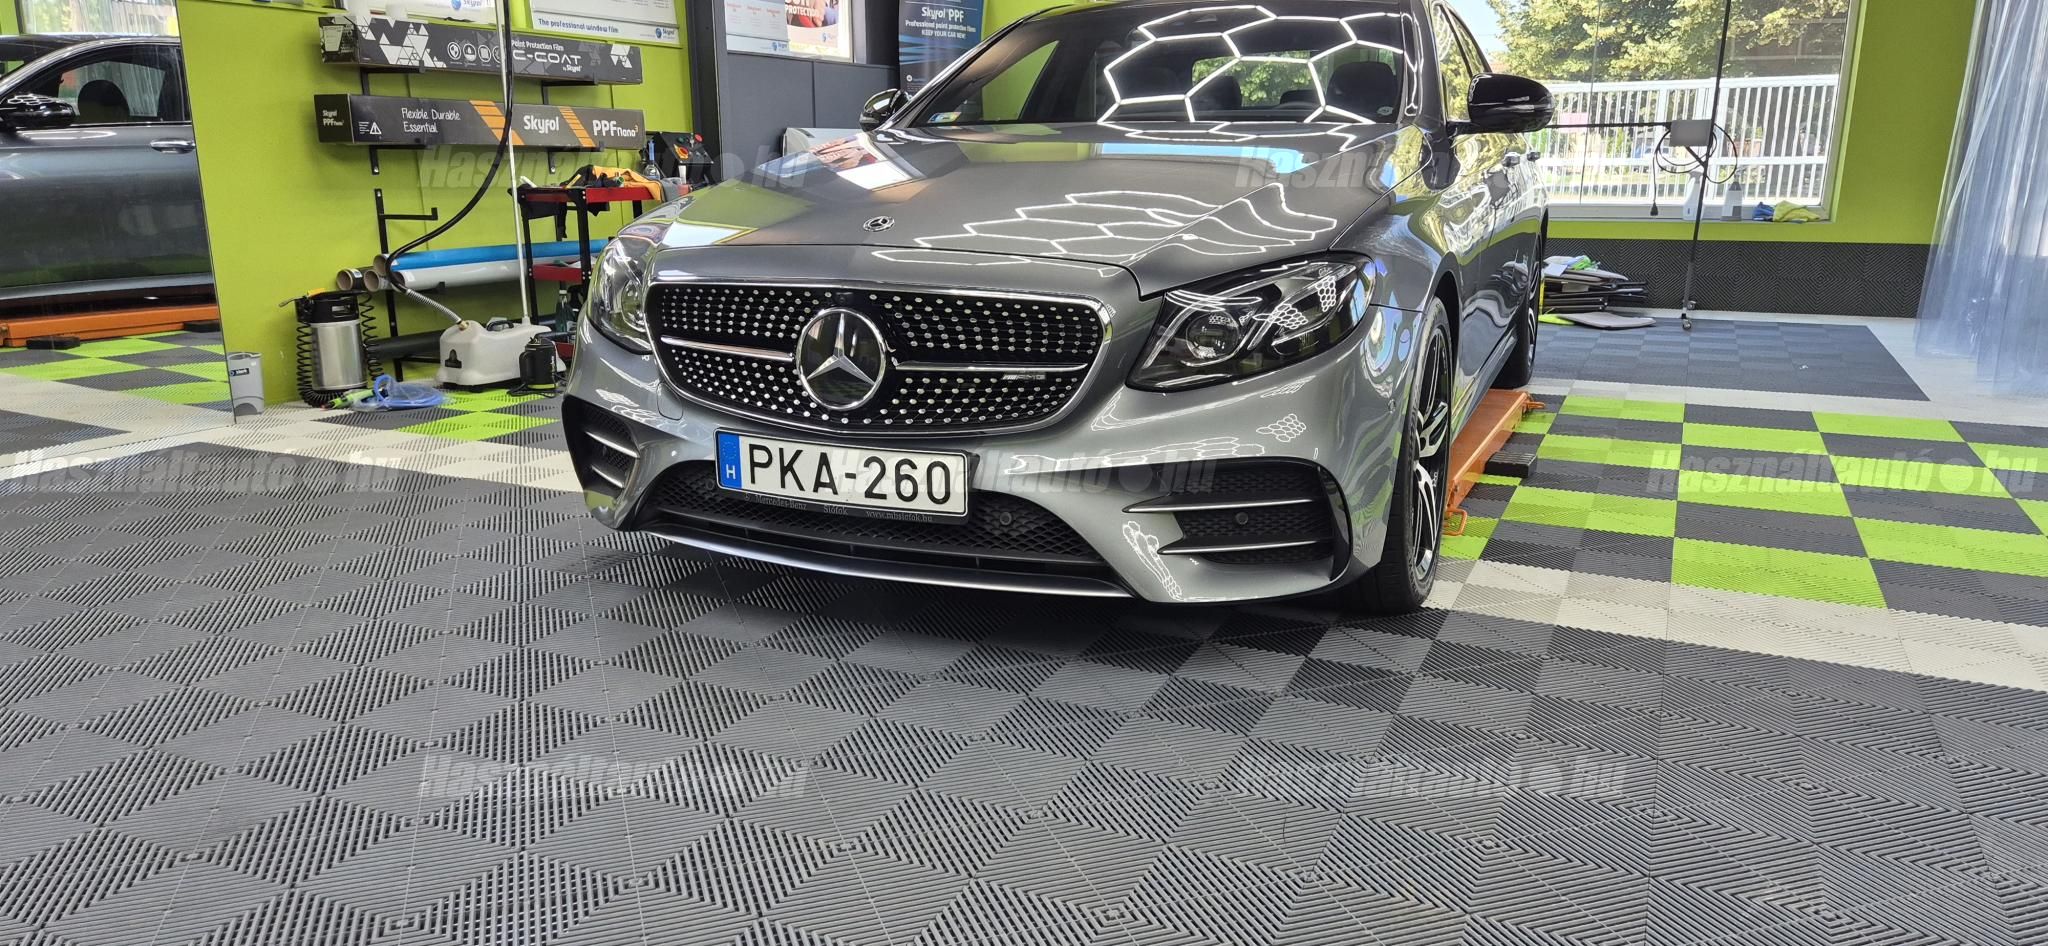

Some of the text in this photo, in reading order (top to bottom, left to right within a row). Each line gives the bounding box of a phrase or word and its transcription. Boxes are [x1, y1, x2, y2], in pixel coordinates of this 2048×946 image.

[921, 7, 964, 22] Skyfol PPF
[550, 20, 585, 30] professional
[586, 24, 608, 33] window
[905, 20, 935, 28] Professional
[526, 41, 552, 50] Protection
[553, 43, 564, 51] Film
[401, 107, 461, 121] Flexible Durable
[403, 122, 438, 133] Essential
[523, 114, 560, 134] Skyfol
[725, 464, 737, 480] H
[748, 443, 952, 505] PKA-260
